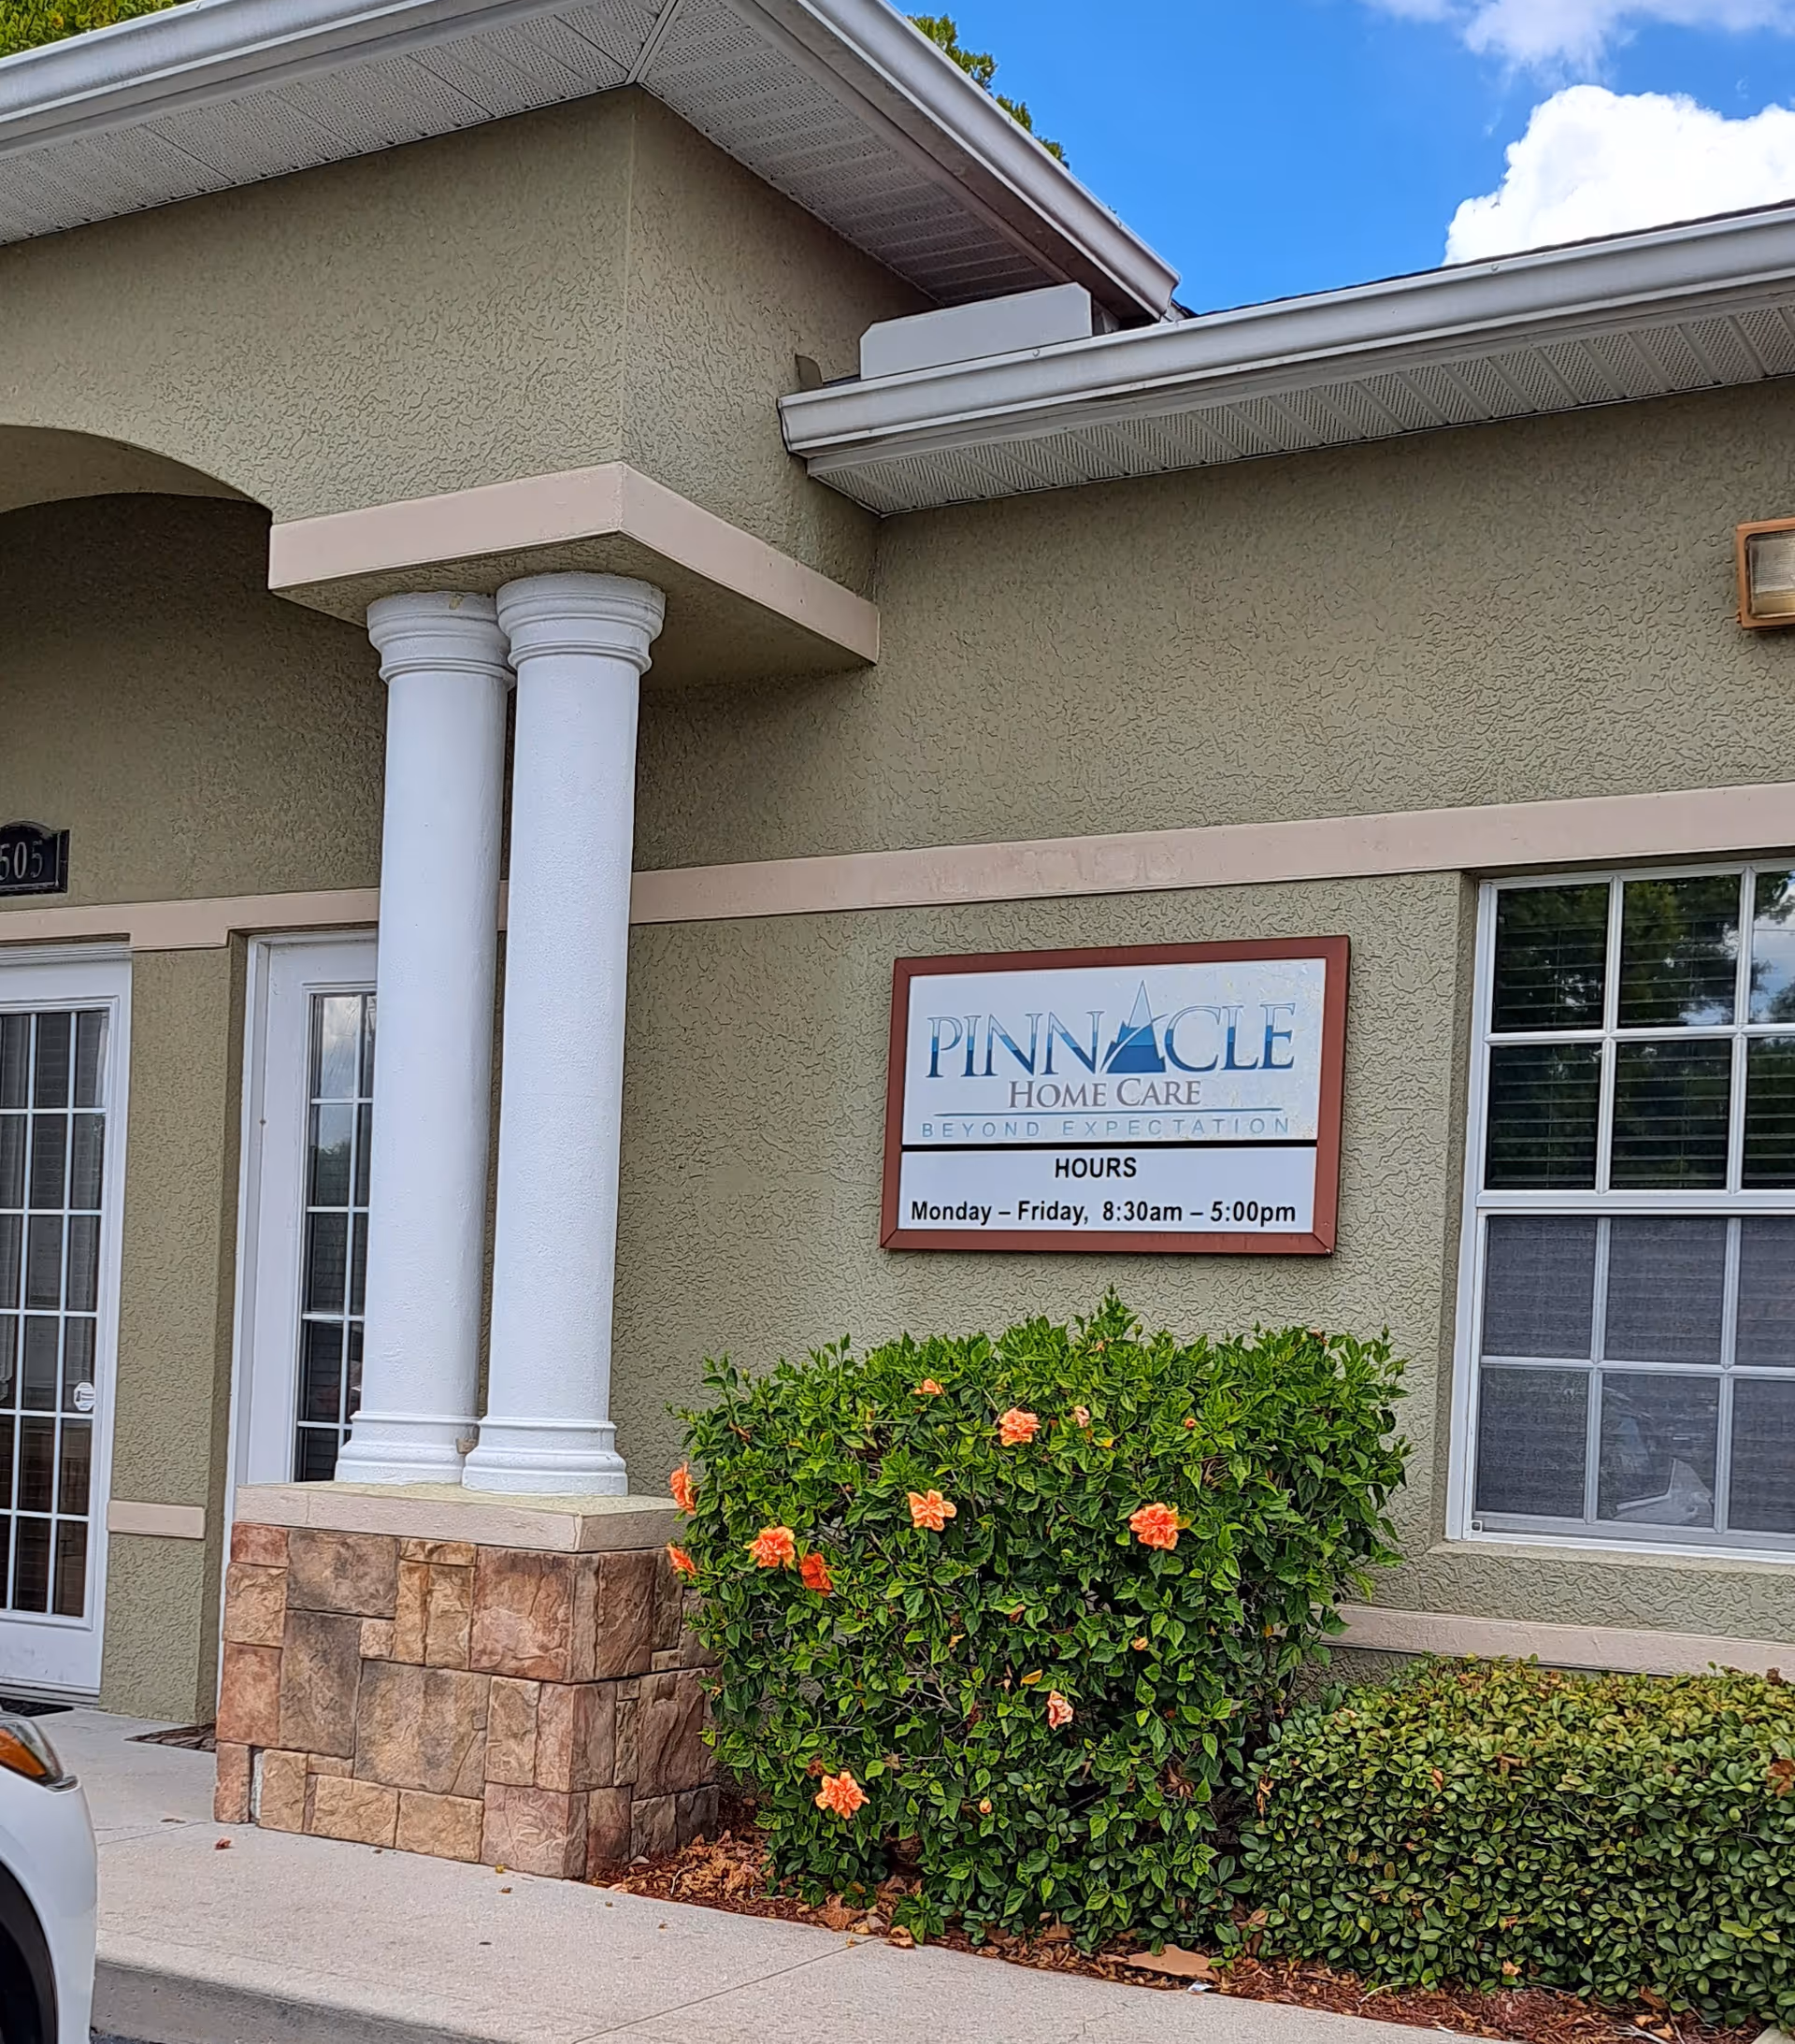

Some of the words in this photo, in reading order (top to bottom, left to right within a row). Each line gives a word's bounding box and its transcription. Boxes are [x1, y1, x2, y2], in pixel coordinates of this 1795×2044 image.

[926, 980, 1296, 1078] PINNACLE
[922, 1122, 1040, 1138] BEYOND
[1062, 1117, 1288, 1137] EXPECTATION
[1055, 1157, 1137, 1178] HOURS
[911, 1201, 992, 1226] Monday
[1018, 1201, 1088, 1226] Friday,
[1102, 1201, 1183, 1222] 8:30am
[1210, 1201, 1296, 1227] 5:00pm
